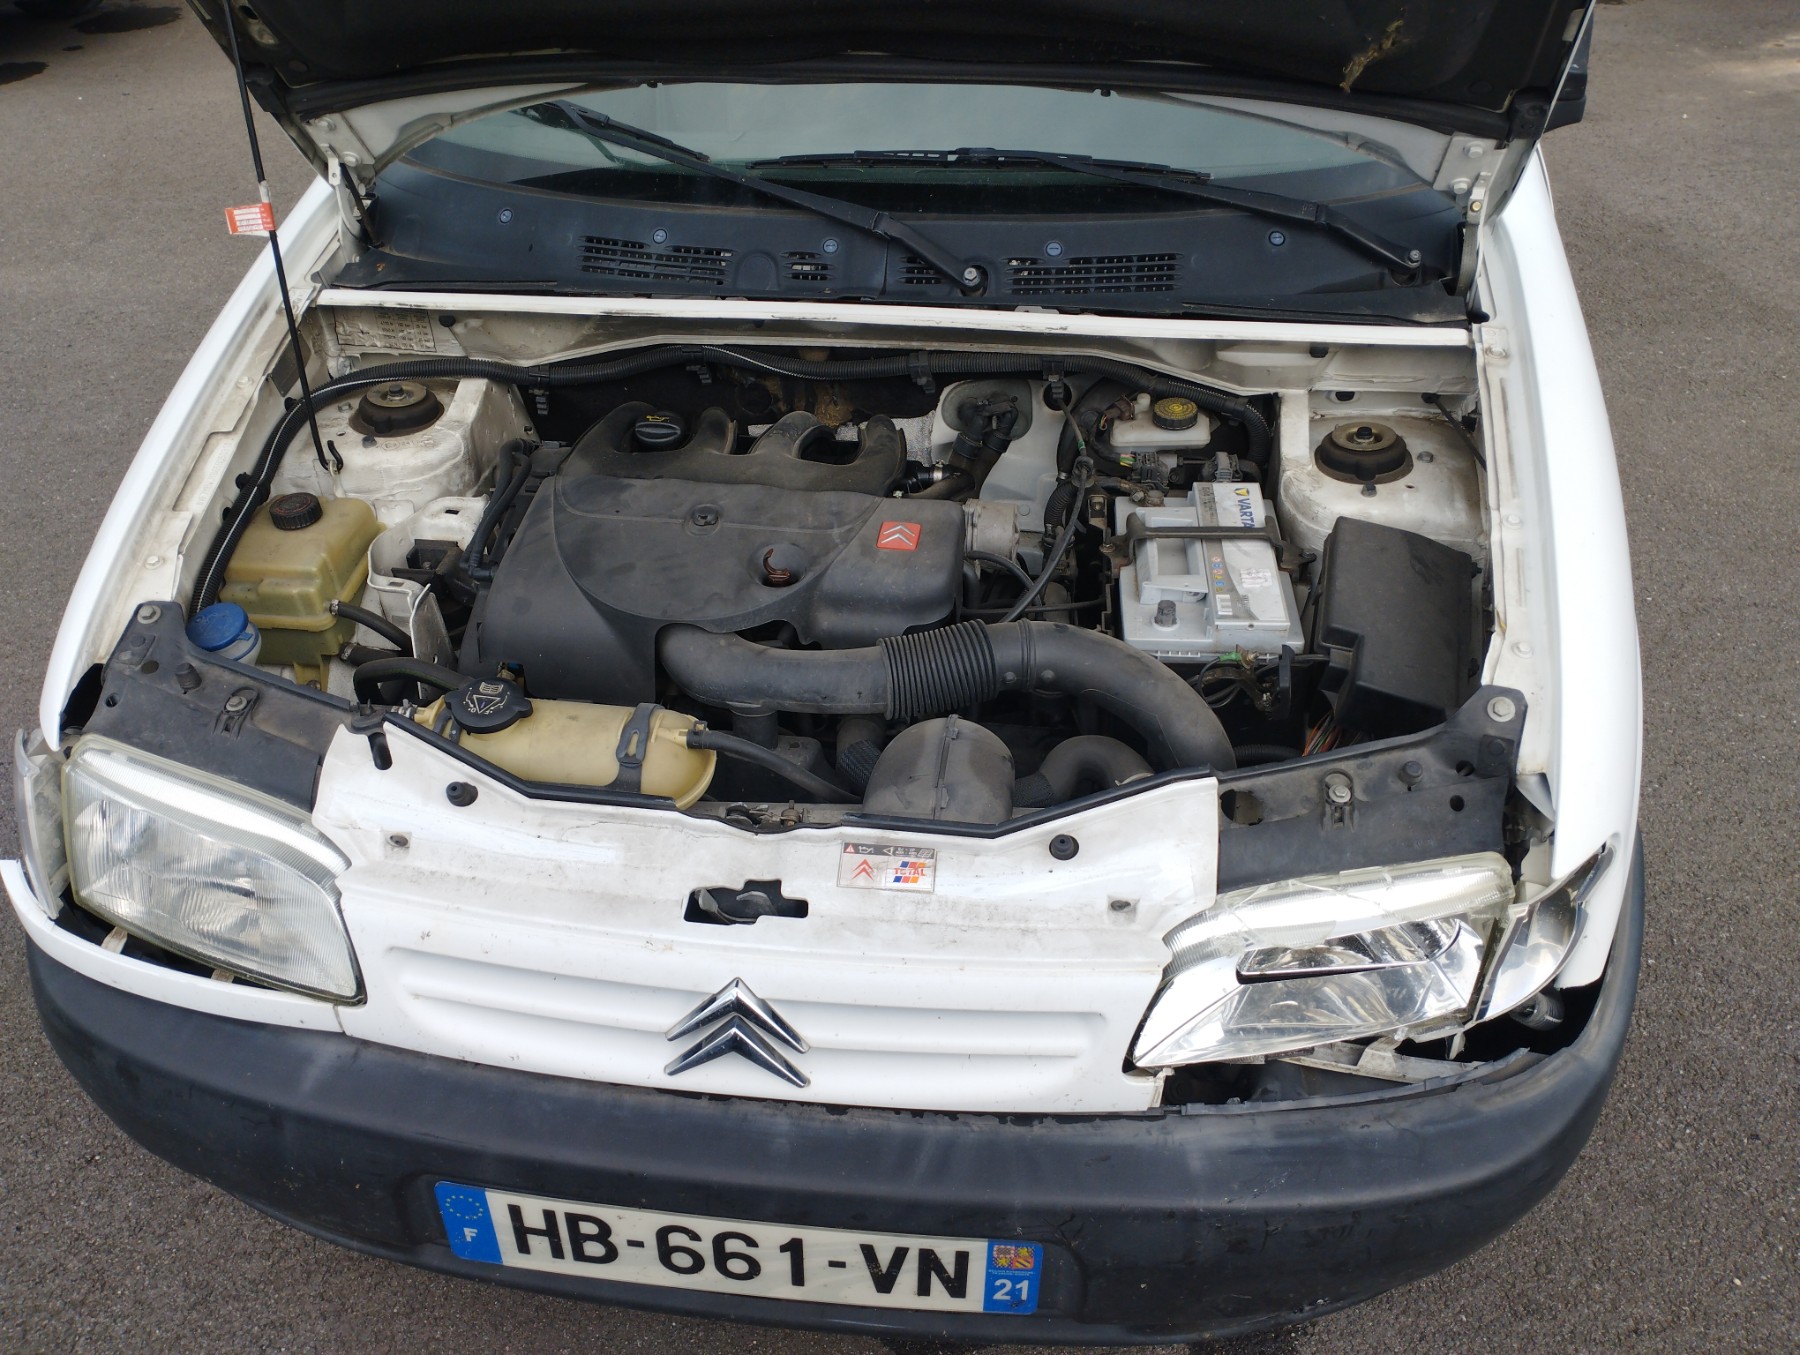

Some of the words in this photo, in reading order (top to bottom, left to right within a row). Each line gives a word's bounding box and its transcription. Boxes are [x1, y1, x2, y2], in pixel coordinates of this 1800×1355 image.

[1238, 498, 1255, 528] VARTA
[463, 1227, 478, 1242] F
[507, 1203, 971, 1299] HB-661-VN
[992, 1278, 1029, 1301] 21
